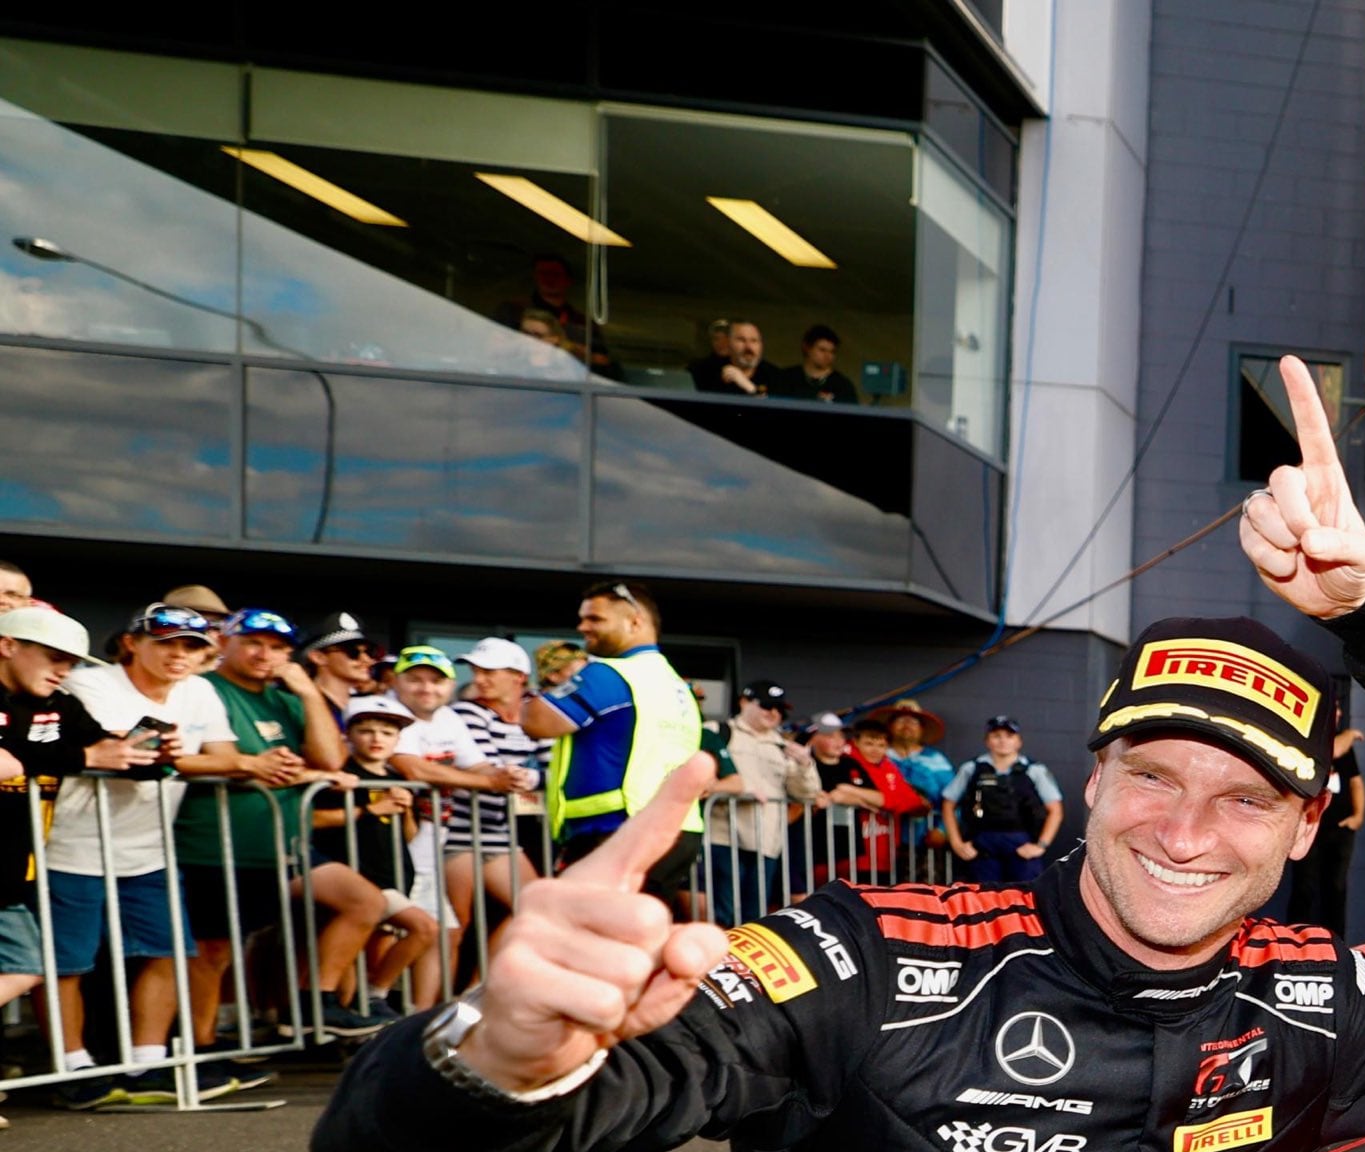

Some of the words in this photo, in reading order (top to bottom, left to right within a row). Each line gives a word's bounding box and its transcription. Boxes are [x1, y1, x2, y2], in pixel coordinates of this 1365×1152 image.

[1144, 648, 1309, 718] PIRELLI
[1275, 980, 1334, 1006] OMP
[1002, 1093, 1094, 1116] AMG
